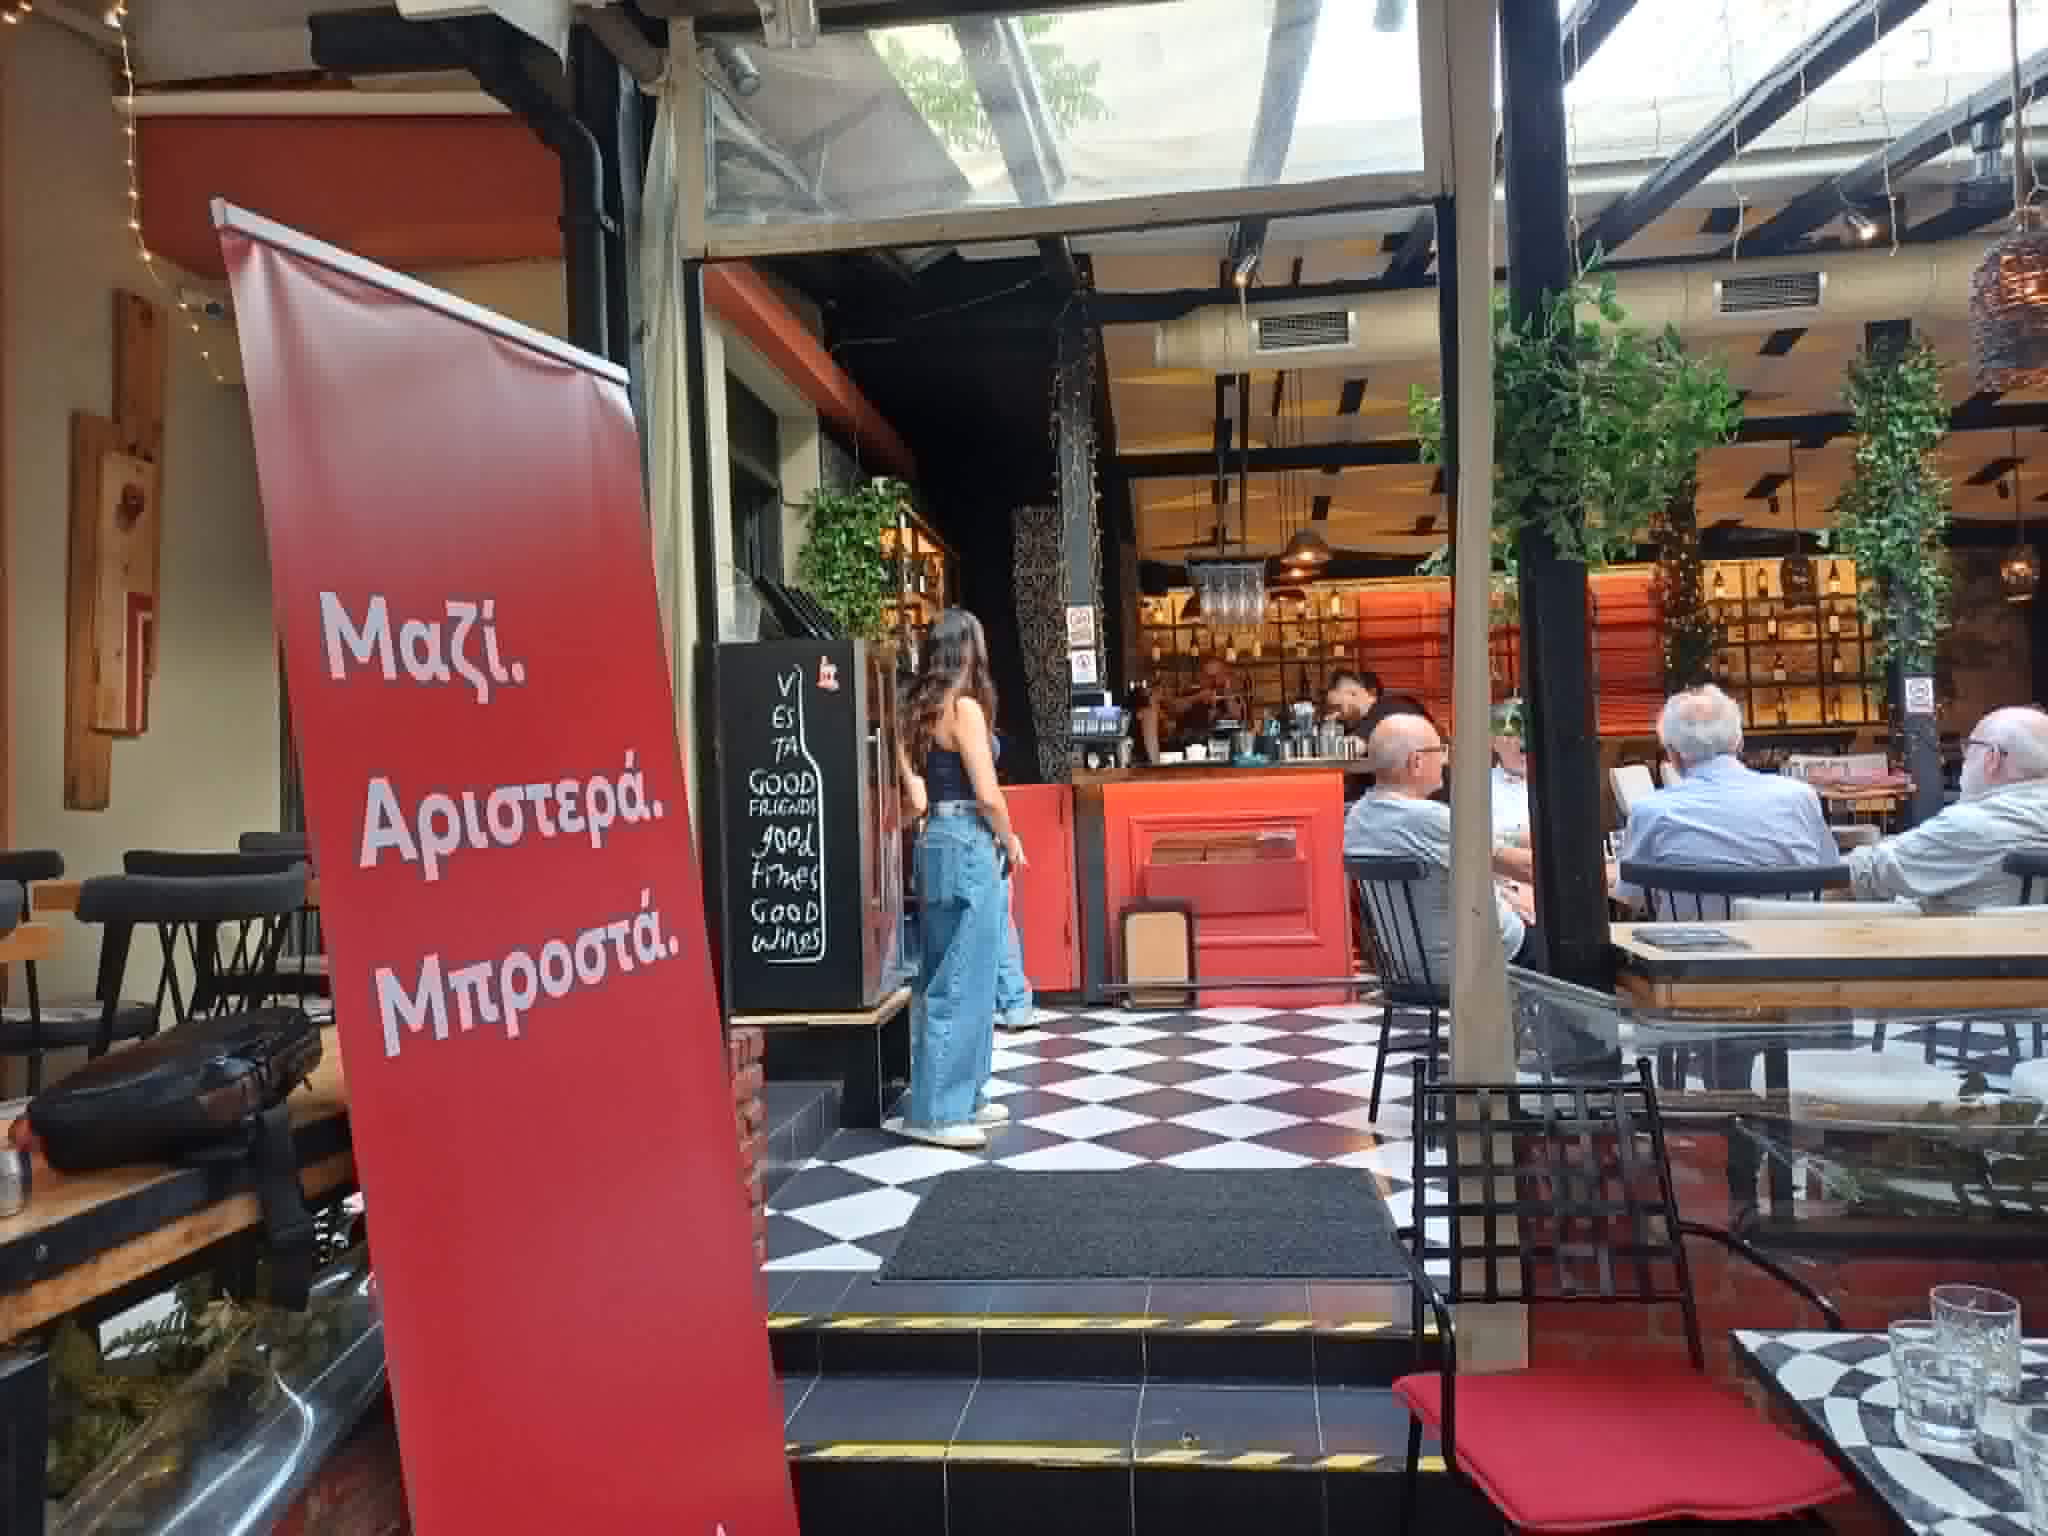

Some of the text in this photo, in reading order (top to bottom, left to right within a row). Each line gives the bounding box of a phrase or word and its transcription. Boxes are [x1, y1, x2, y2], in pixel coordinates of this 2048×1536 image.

[319, 591, 526, 705] Μαζί.
[359, 748, 664, 881] Αριστερά.
[749, 768, 816, 796] GOOD
[374, 887, 681, 1057] Μπροστά.
